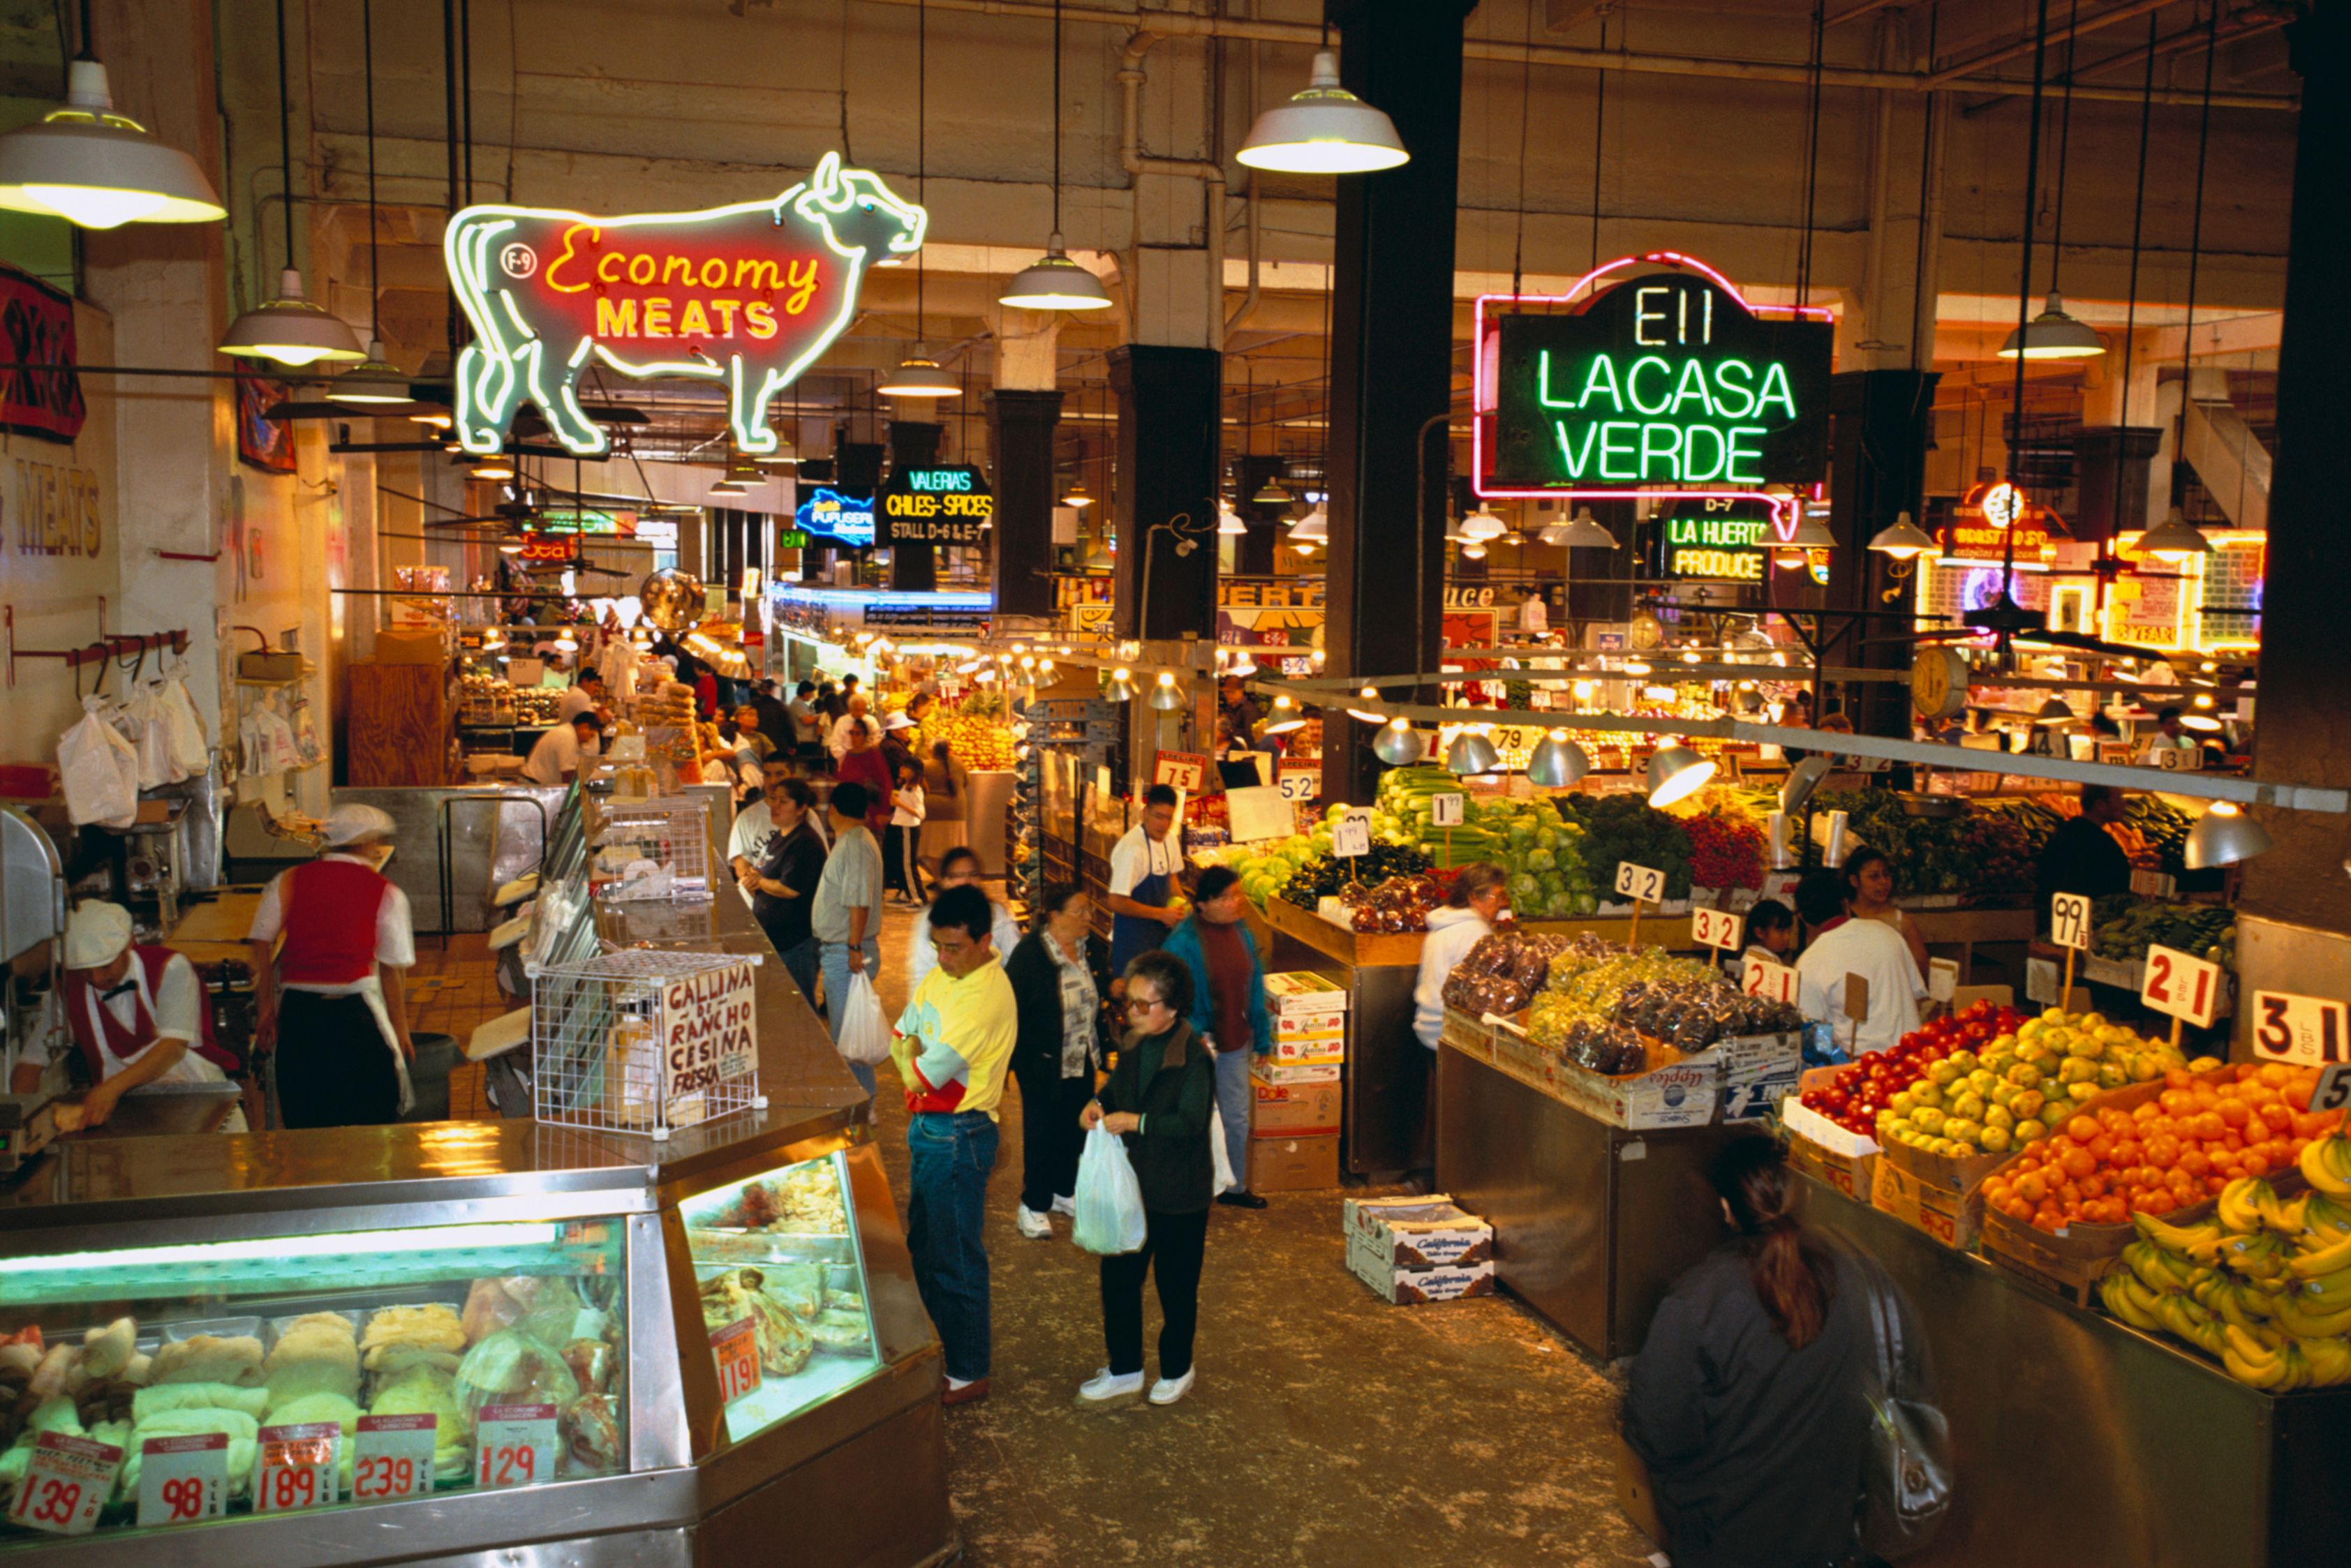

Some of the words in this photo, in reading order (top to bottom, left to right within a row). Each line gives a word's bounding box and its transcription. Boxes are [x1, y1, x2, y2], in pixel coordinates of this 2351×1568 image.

[507, 251, 532, 271] F-9
[545, 224, 819, 315] Economy
[596, 298, 779, 341] MEATS
[1556, 420, 1769, 484] VERDE
[16, 458, 101, 559] MEATS
[943, 493, 993, 517] SPICES
[1705, 498, 1735, 513] D-7
[890, 523, 925, 539] STALL
[927, 523, 950, 539] D-6
[951, 524, 963, 539] &
[1670, 518, 1698, 543] LA
[1675, 550, 1765, 579] PRODUCE
[1497, 729, 1523, 749] 79
[1161, 752, 1200, 764] SPECIAL
[2165, 752, 2177, 769] 3
[1168, 768, 1192, 787] 75
[1281, 779, 1295, 799] 5
[1299, 777, 1312, 798] 2
[1447, 796, 1460, 807] 99
[1621, 866, 1633, 891] 3
[1642, 872, 1657, 899] 2
[1698, 911, 1710, 939] 3
[1720, 916, 1733, 946] 2
[2055, 897, 2083, 943] 99
[669, 964, 752, 1010] GALLINA
[1749, 964, 1765, 996] 2
[2146, 955, 2172, 1003] 2
[2193, 969, 2209, 1017] 1
[670, 1001, 752, 1047] RANCHO
[2257, 995, 2292, 1055] 3
[2320, 1006, 2338, 1061] 1
[670, 1024, 752, 1072] CESINA
[672, 1062, 720, 1096] FRESCA
[1258, 1085, 1289, 1100] Dole
[1920, 1207, 1955, 1243] Dole
[1416, 1237, 1472, 1250] California
[1418, 1273, 1473, 1287] California
[355, 1455, 413, 1498] 239
[481, 1445, 535, 1486] 129
[16, 1473, 82, 1526] 139
[161, 1477, 204, 1521] 98
[259, 1468, 316, 1511] 189
